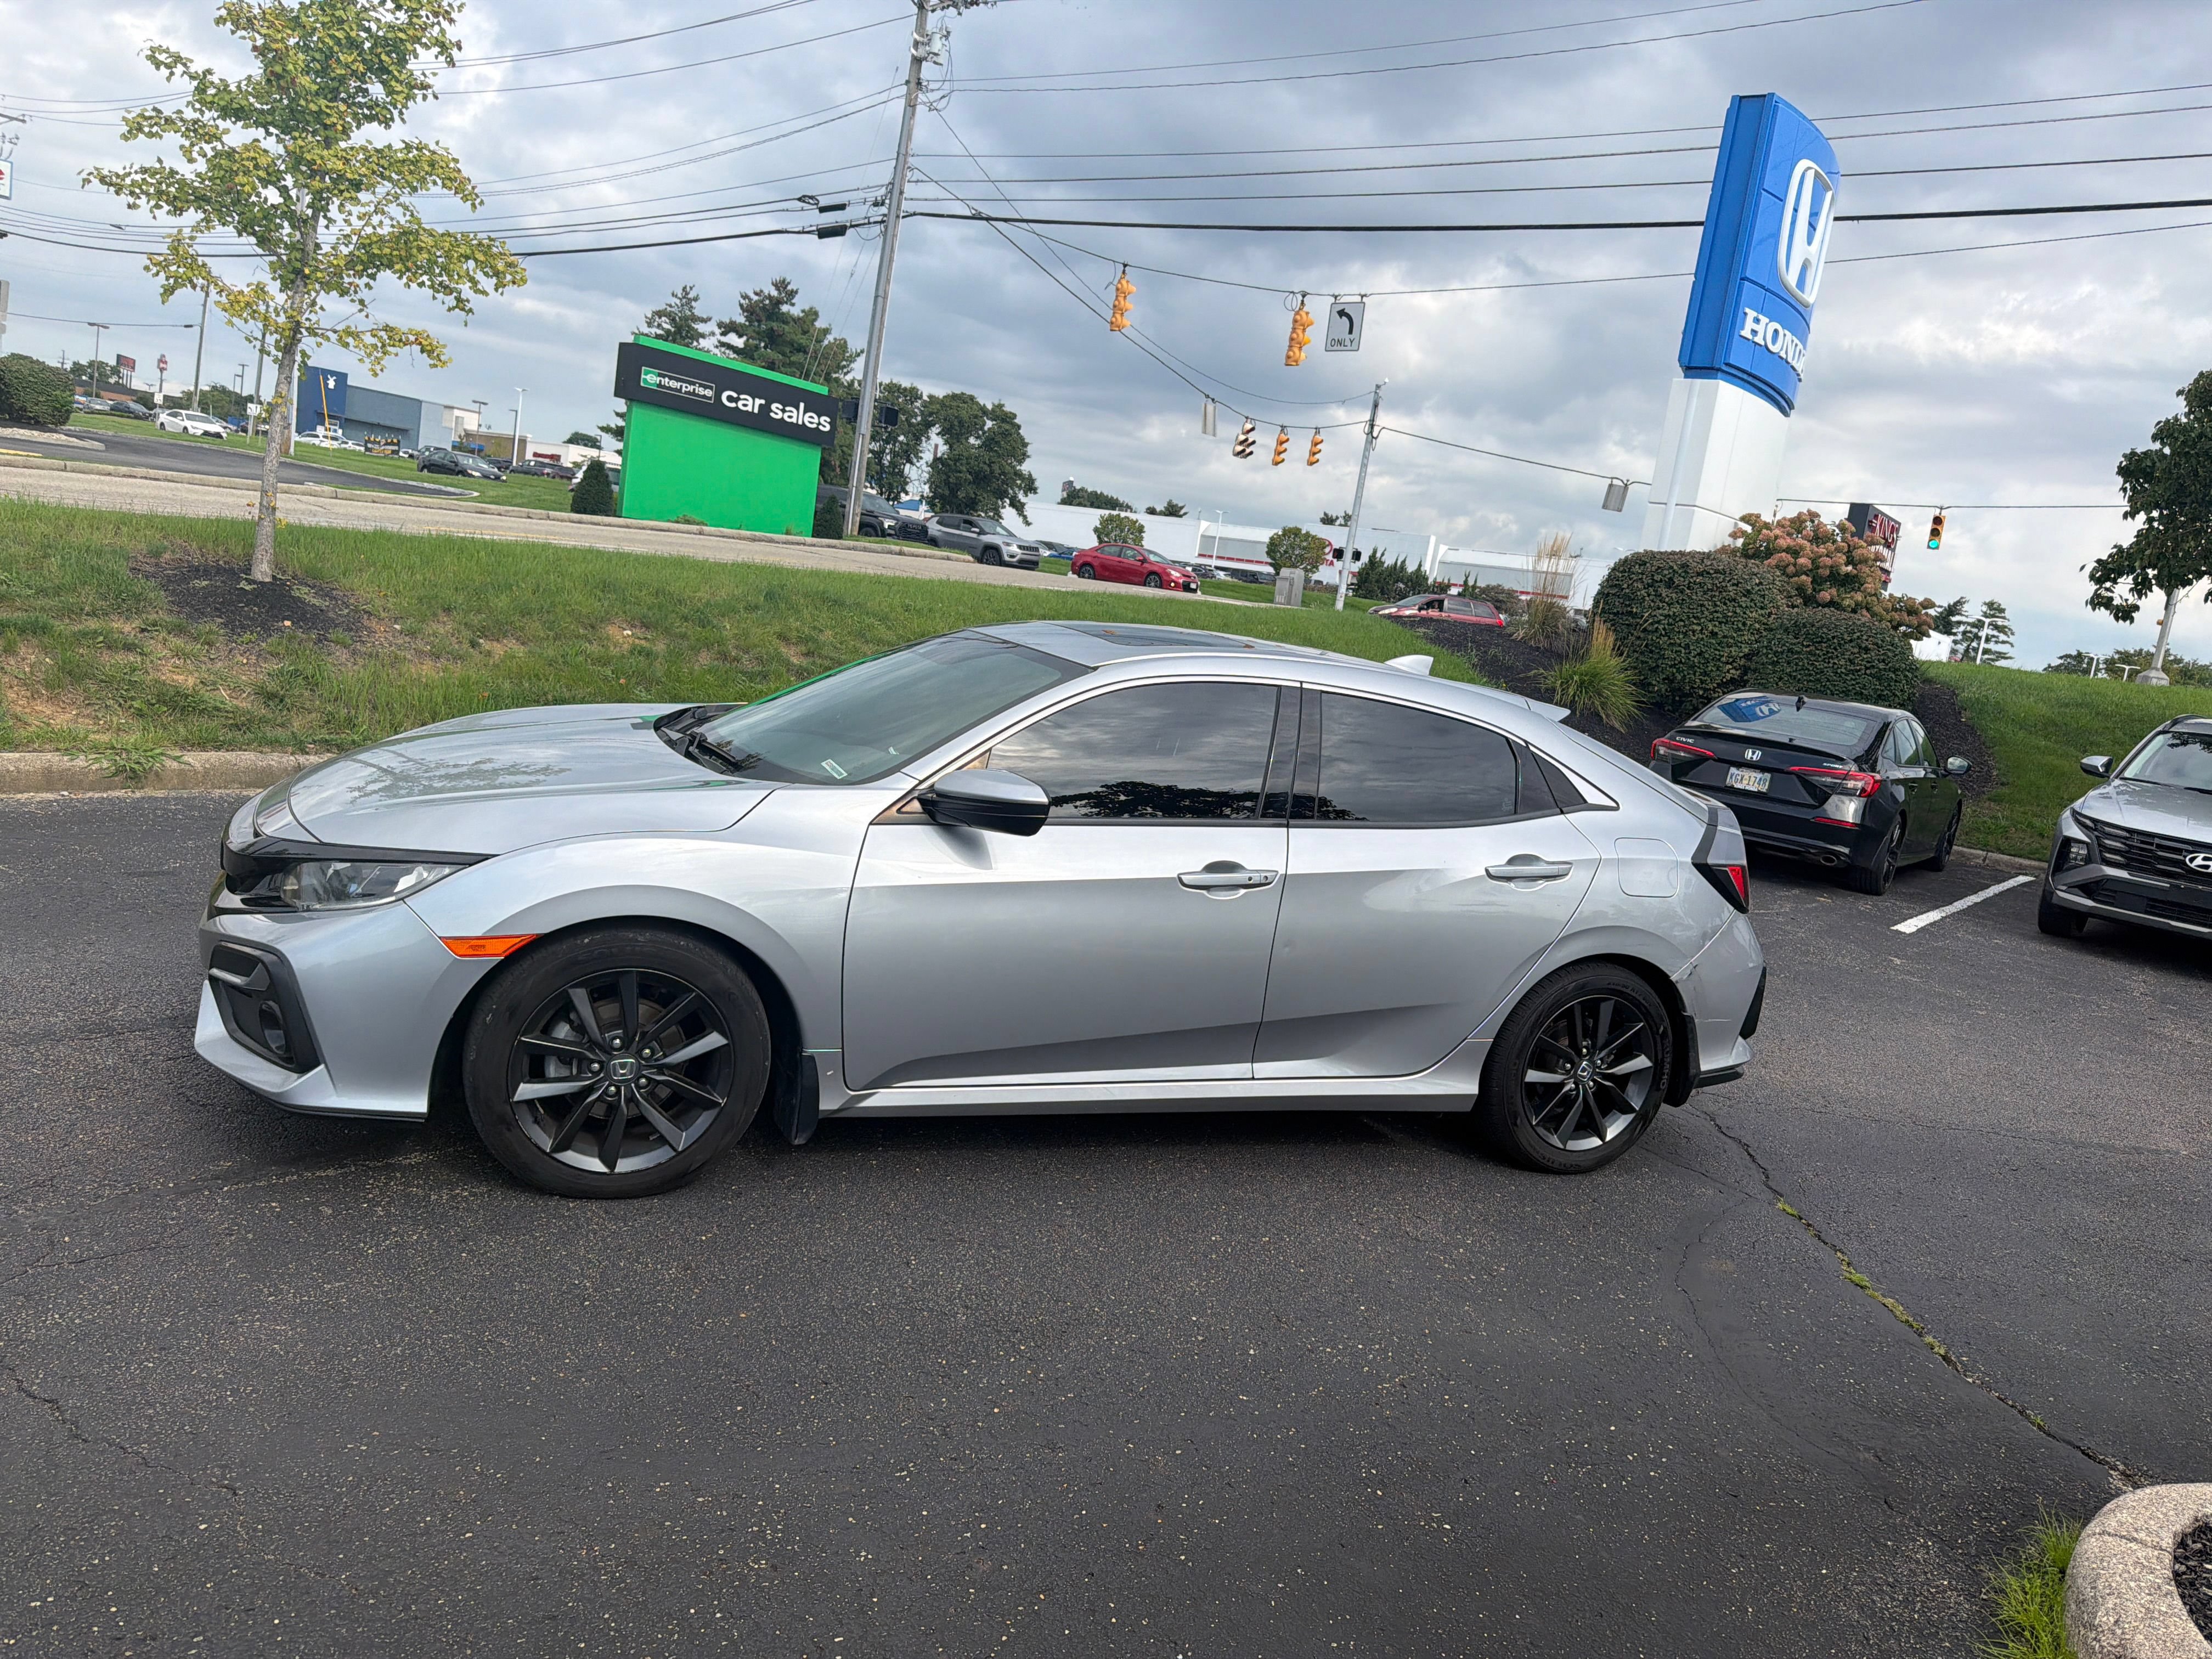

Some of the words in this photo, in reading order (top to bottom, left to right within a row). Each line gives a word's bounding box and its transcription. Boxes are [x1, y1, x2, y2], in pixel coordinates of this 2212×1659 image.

[1330, 337, 1356, 347] ONLY
[646, 374, 713, 397] enterprise
[721, 390, 766, 414] car
[769, 402, 831, 432] sales
